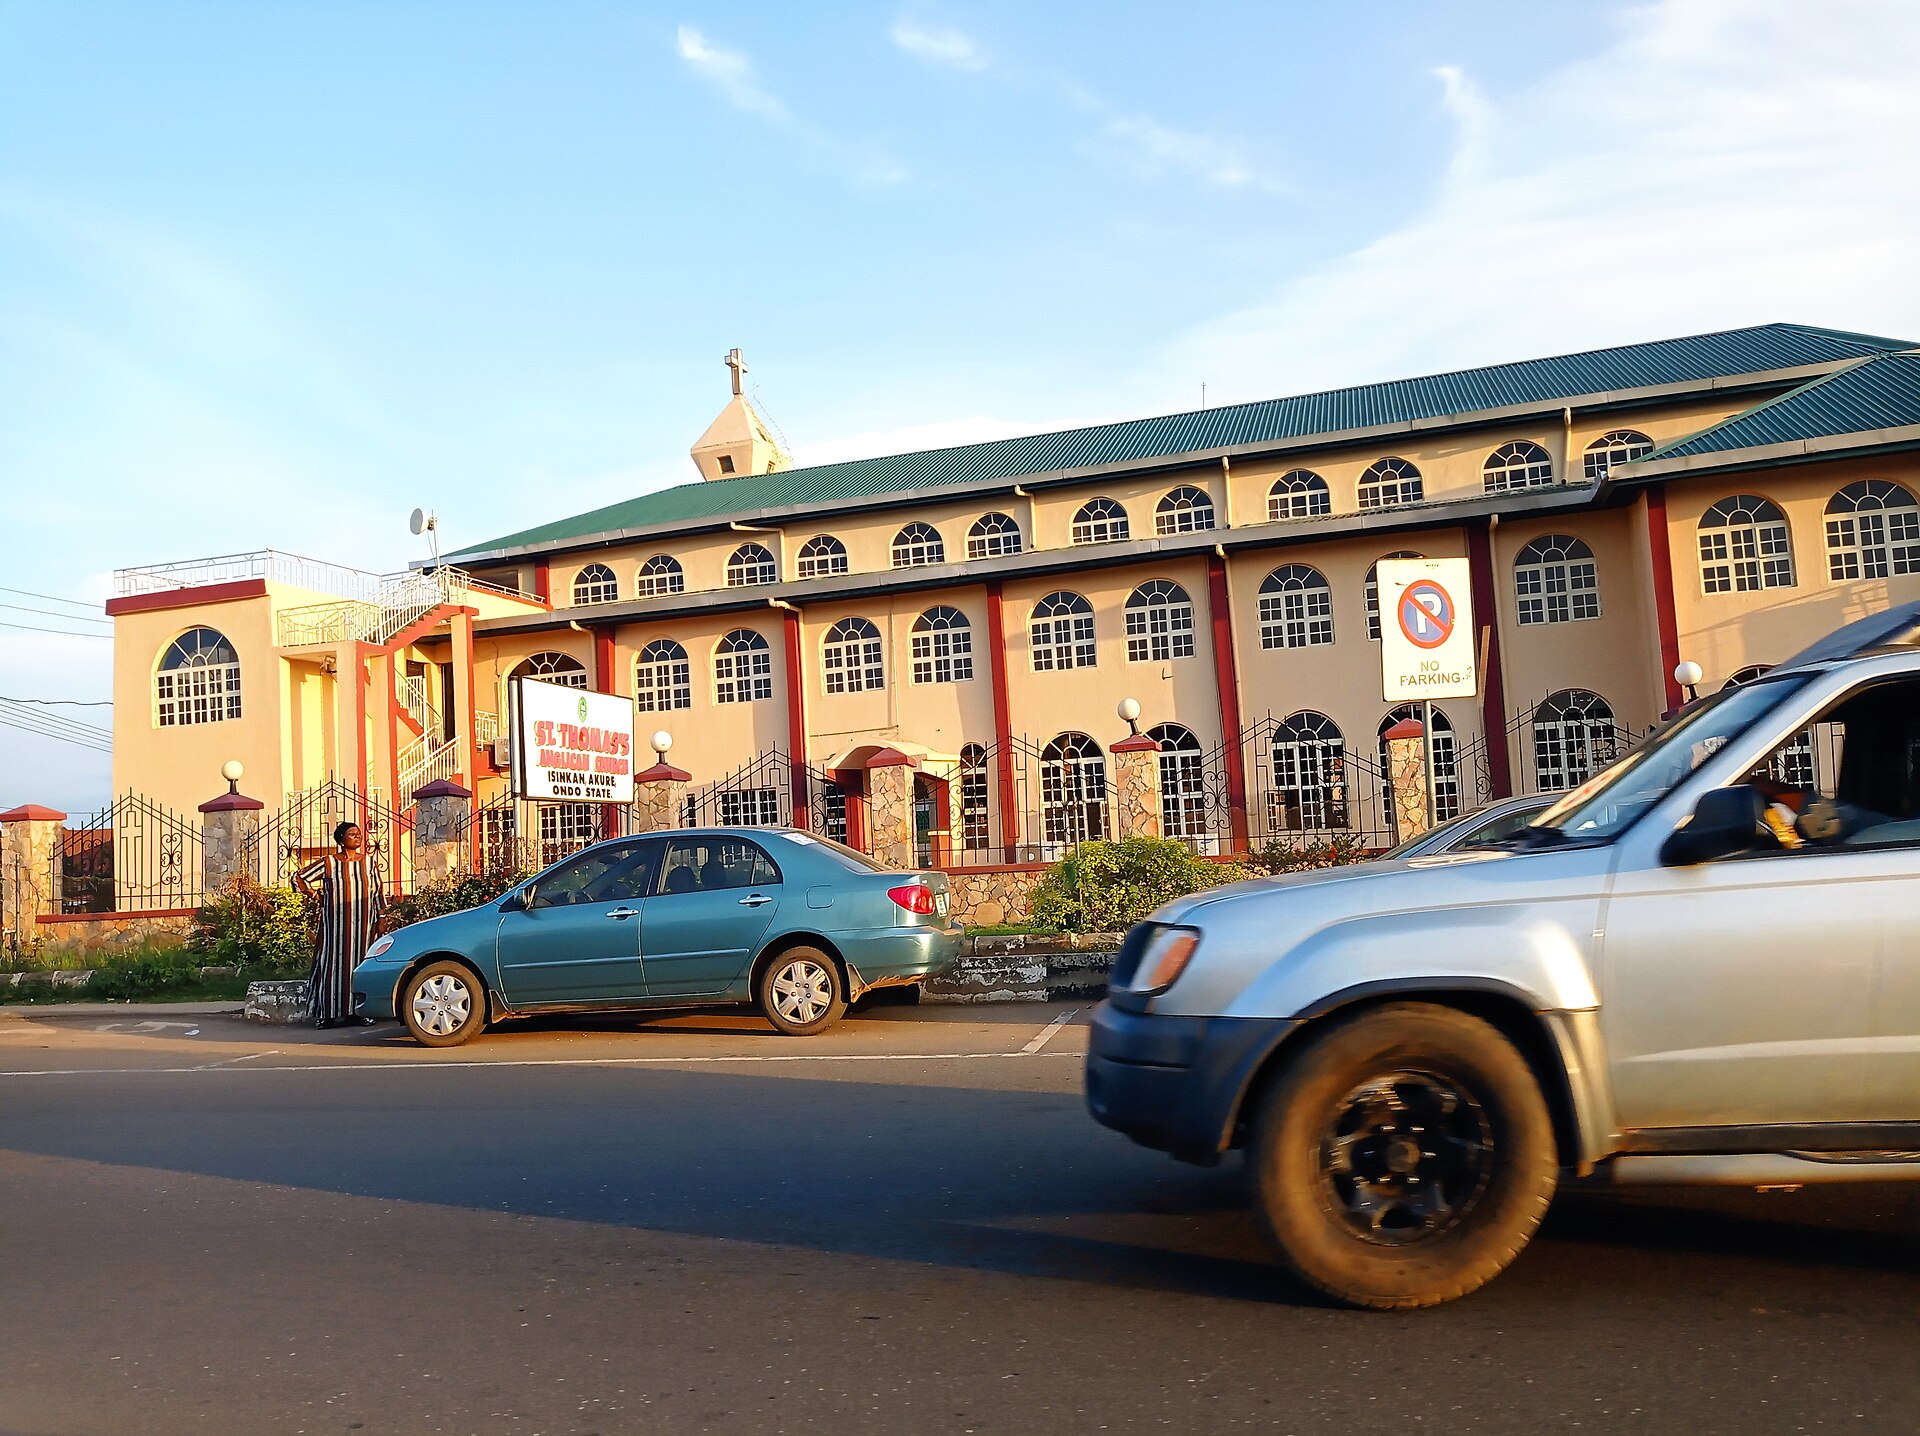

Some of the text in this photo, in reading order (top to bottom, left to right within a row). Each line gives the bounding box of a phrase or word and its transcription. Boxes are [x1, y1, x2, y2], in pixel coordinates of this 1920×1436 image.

[1420, 660, 1440, 672] NO
[534, 720, 556, 746] ST.
[537, 749, 590, 771] ANGLICAN
[552, 785, 613, 799] ONDO STATE.
